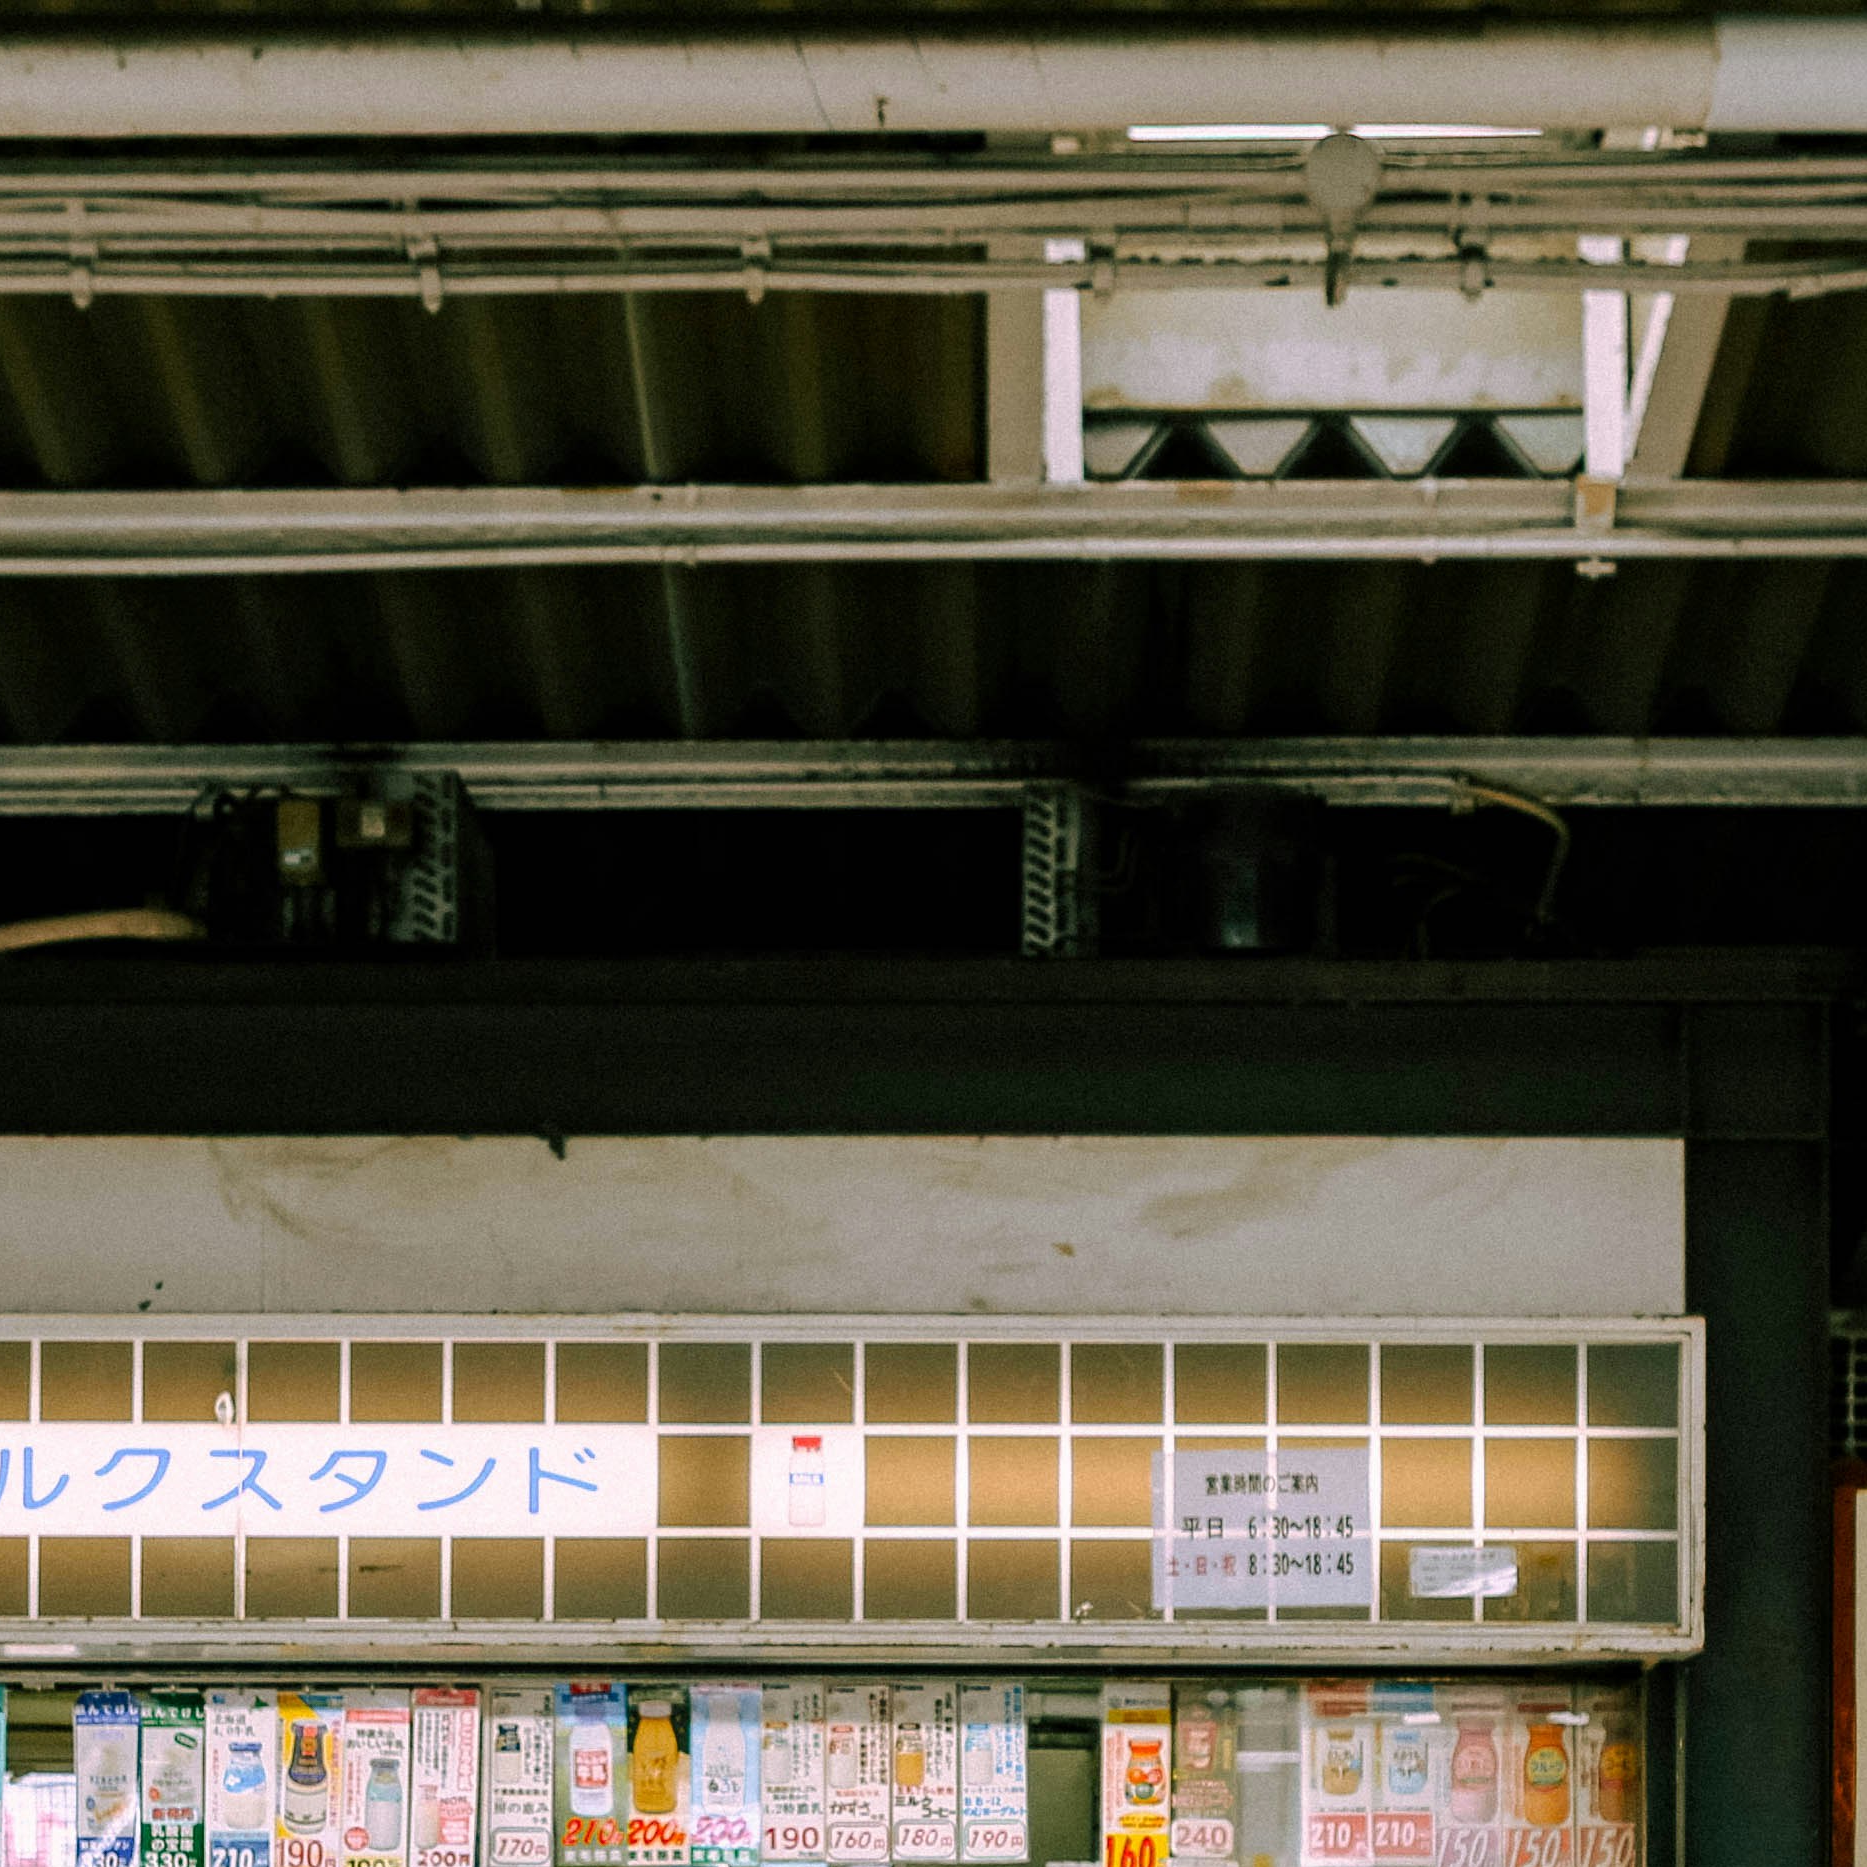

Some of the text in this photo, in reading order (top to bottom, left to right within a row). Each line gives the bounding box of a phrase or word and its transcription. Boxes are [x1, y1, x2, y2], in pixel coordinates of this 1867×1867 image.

[1204, 1473, 1320, 1496] 営業時間のご案内
[894, 1795, 934, 1808] ミルク
[921, 1806, 957, 1818] コーヒー
[765, 1827, 820, 1850] 190
[832, 1830, 886, 1850] 160円
[901, 1828, 953, 1848] 180円
[969, 1830, 1024, 1849] 190円
[1175, 1826, 1228, 1848] 240
